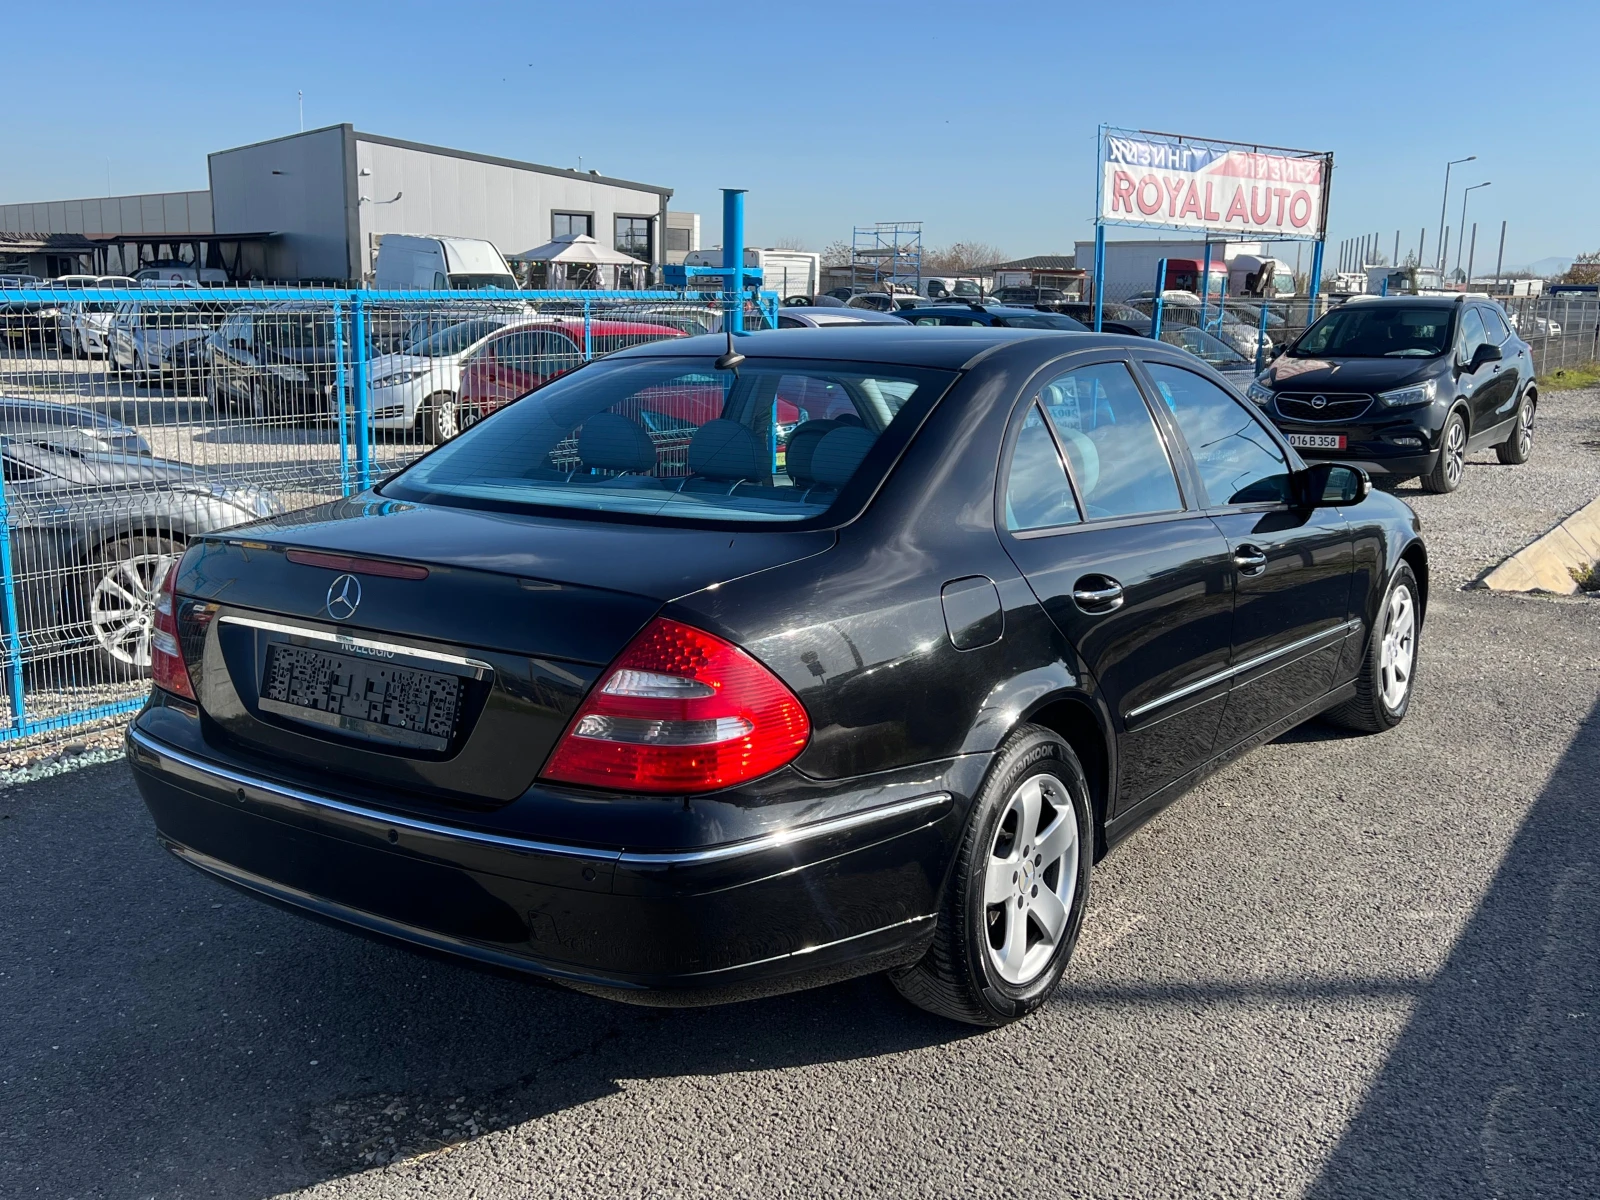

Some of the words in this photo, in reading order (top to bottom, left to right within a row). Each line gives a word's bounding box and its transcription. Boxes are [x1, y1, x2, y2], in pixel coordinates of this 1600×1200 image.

[1112, 170, 1220, 222] ROYAL
[1225, 184, 1312, 228] AUTO
[1290, 435, 1308, 446] 016
[1309, 436, 1316, 446] B
[1317, 436, 1336, 447] 358
